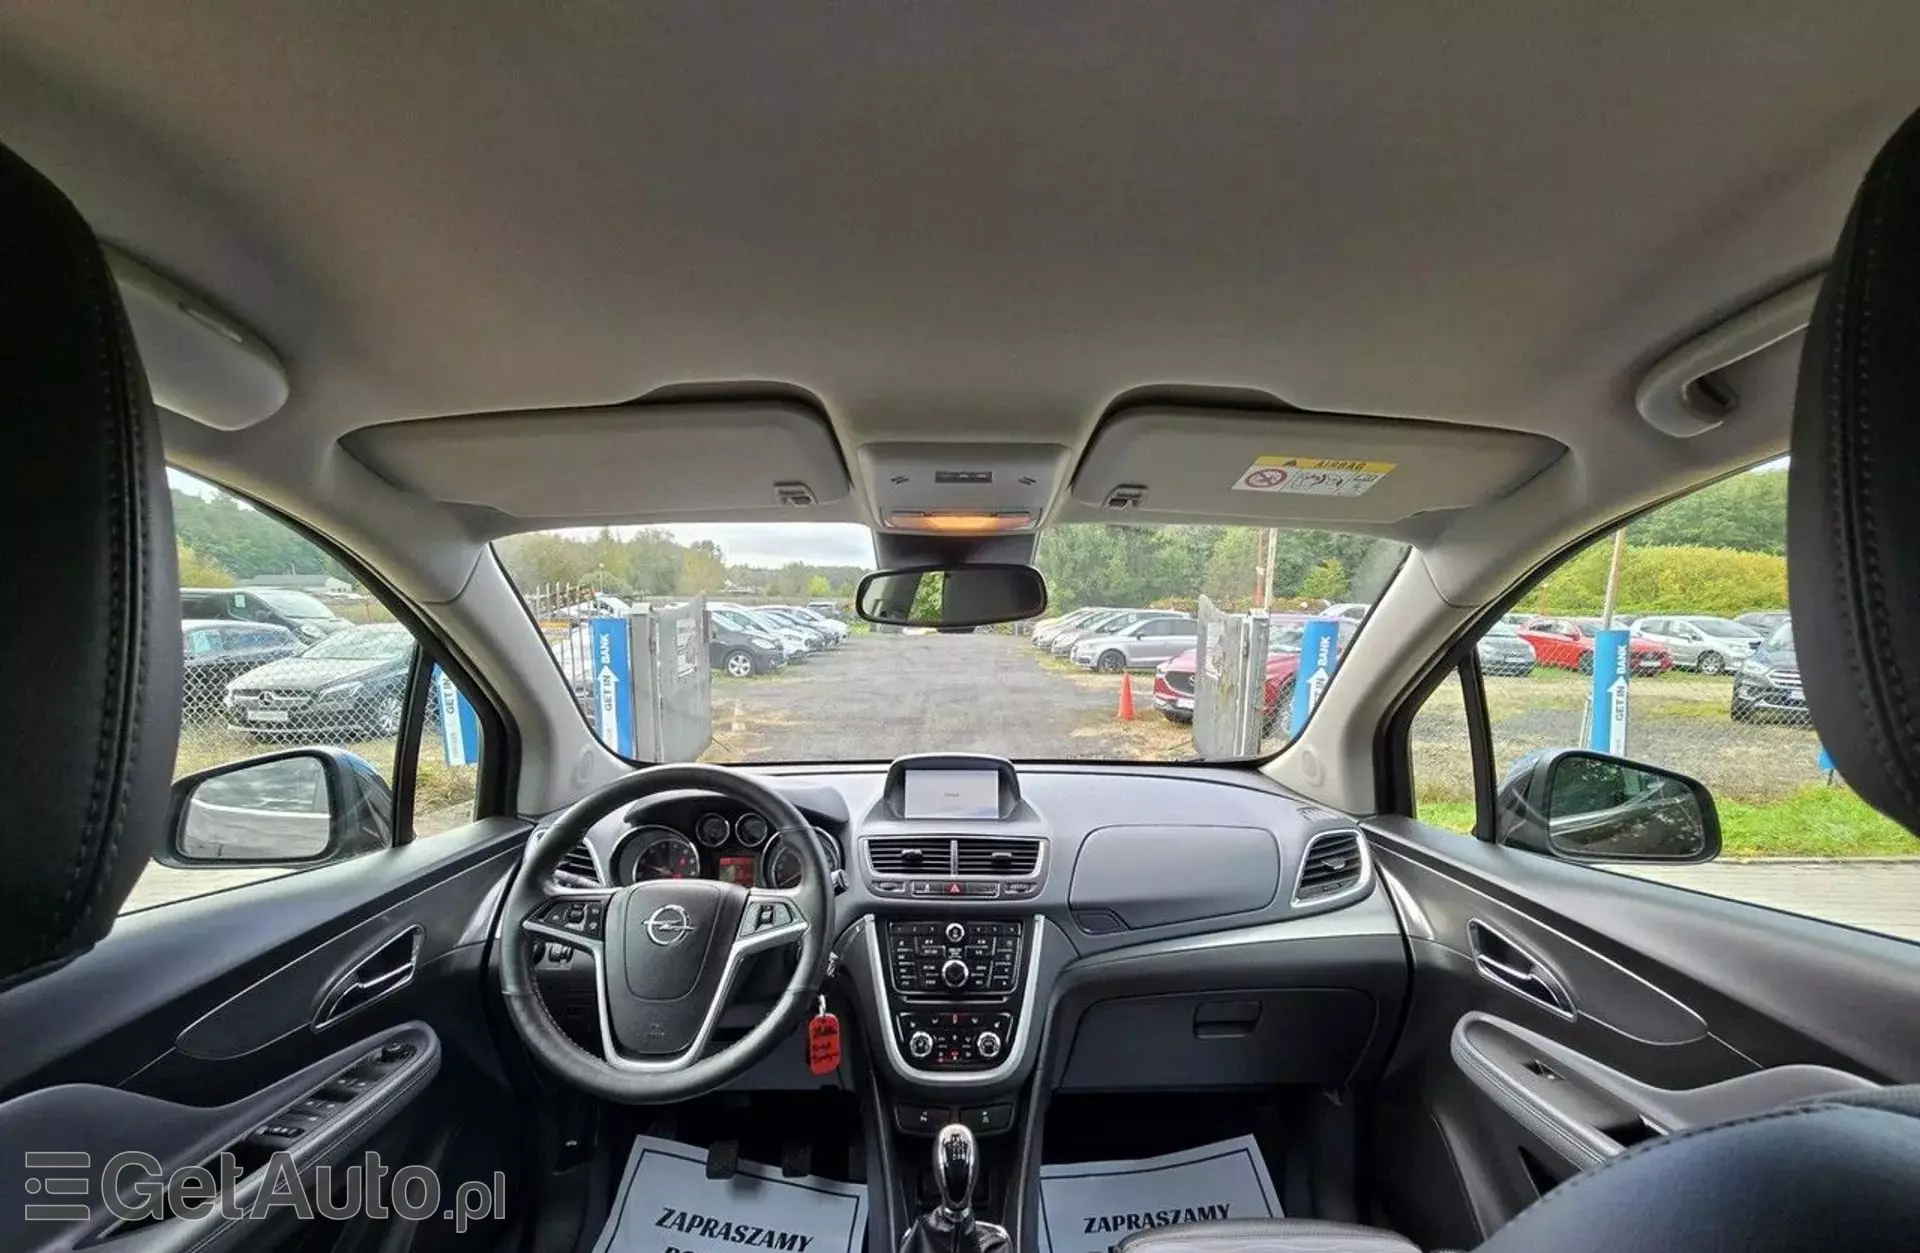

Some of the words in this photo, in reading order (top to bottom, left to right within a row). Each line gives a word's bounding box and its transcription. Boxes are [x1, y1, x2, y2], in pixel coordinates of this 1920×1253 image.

[1314, 460, 1366, 471] AIRBAG
[600, 632, 611, 664] BANK
[1317, 636, 1331, 666] BANK
[1617, 644, 1627, 674] BANK
[655, 1207, 815, 1252] ZAPRASZAMY
[1083, 1203, 1230, 1234] ZAPRASZAMY
